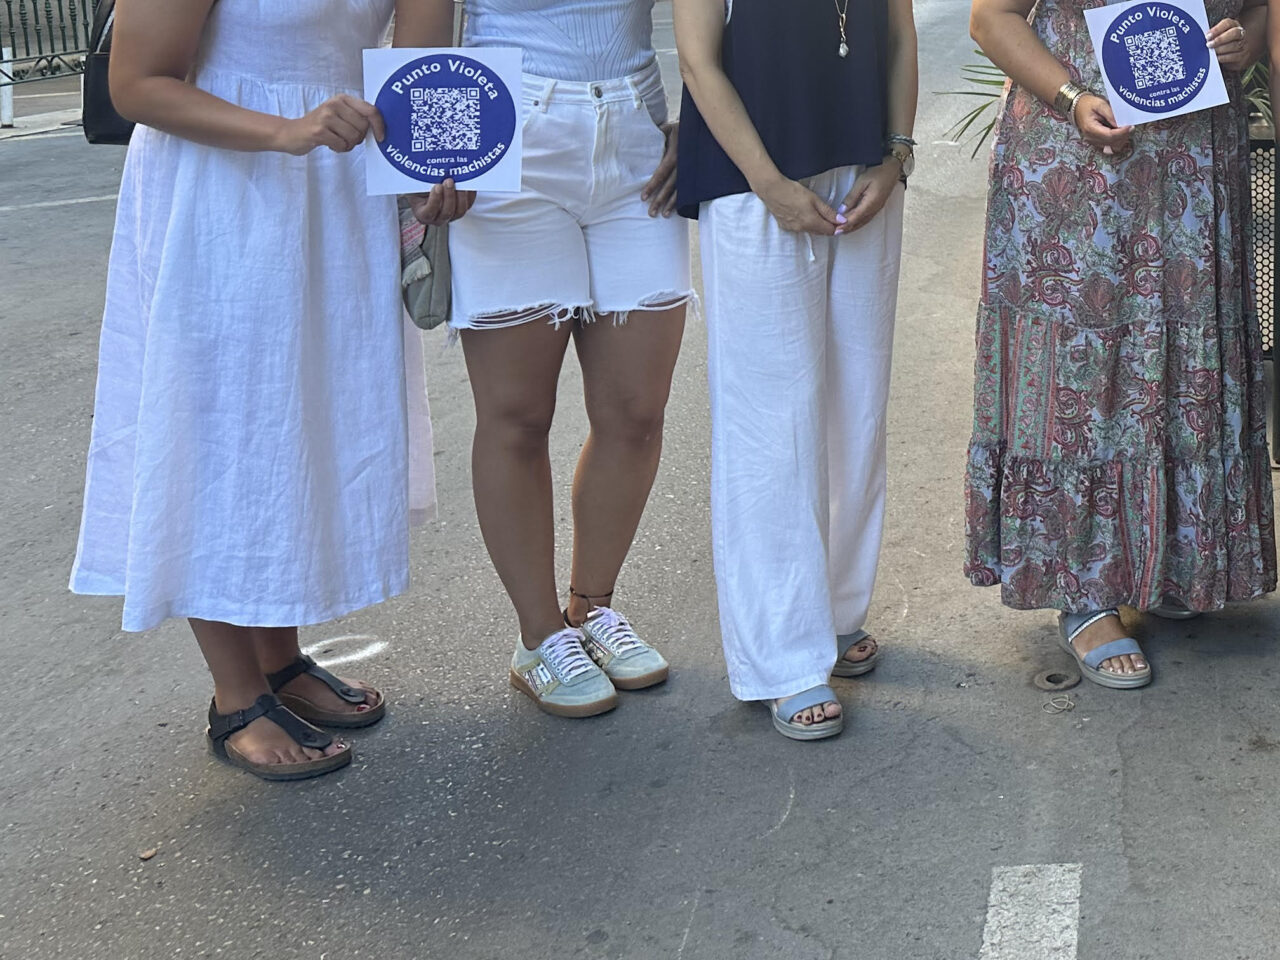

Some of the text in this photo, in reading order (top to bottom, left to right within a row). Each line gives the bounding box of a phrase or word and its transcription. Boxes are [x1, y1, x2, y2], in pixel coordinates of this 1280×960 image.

[1110, 6, 1190, 44] Punto Violeta
[391, 60, 498, 100] Punto Violeta
[1120, 67, 1206, 107] violencias machistas
[1150, 89, 1170, 98] contra
[386, 142, 506, 177] violencias machistas
